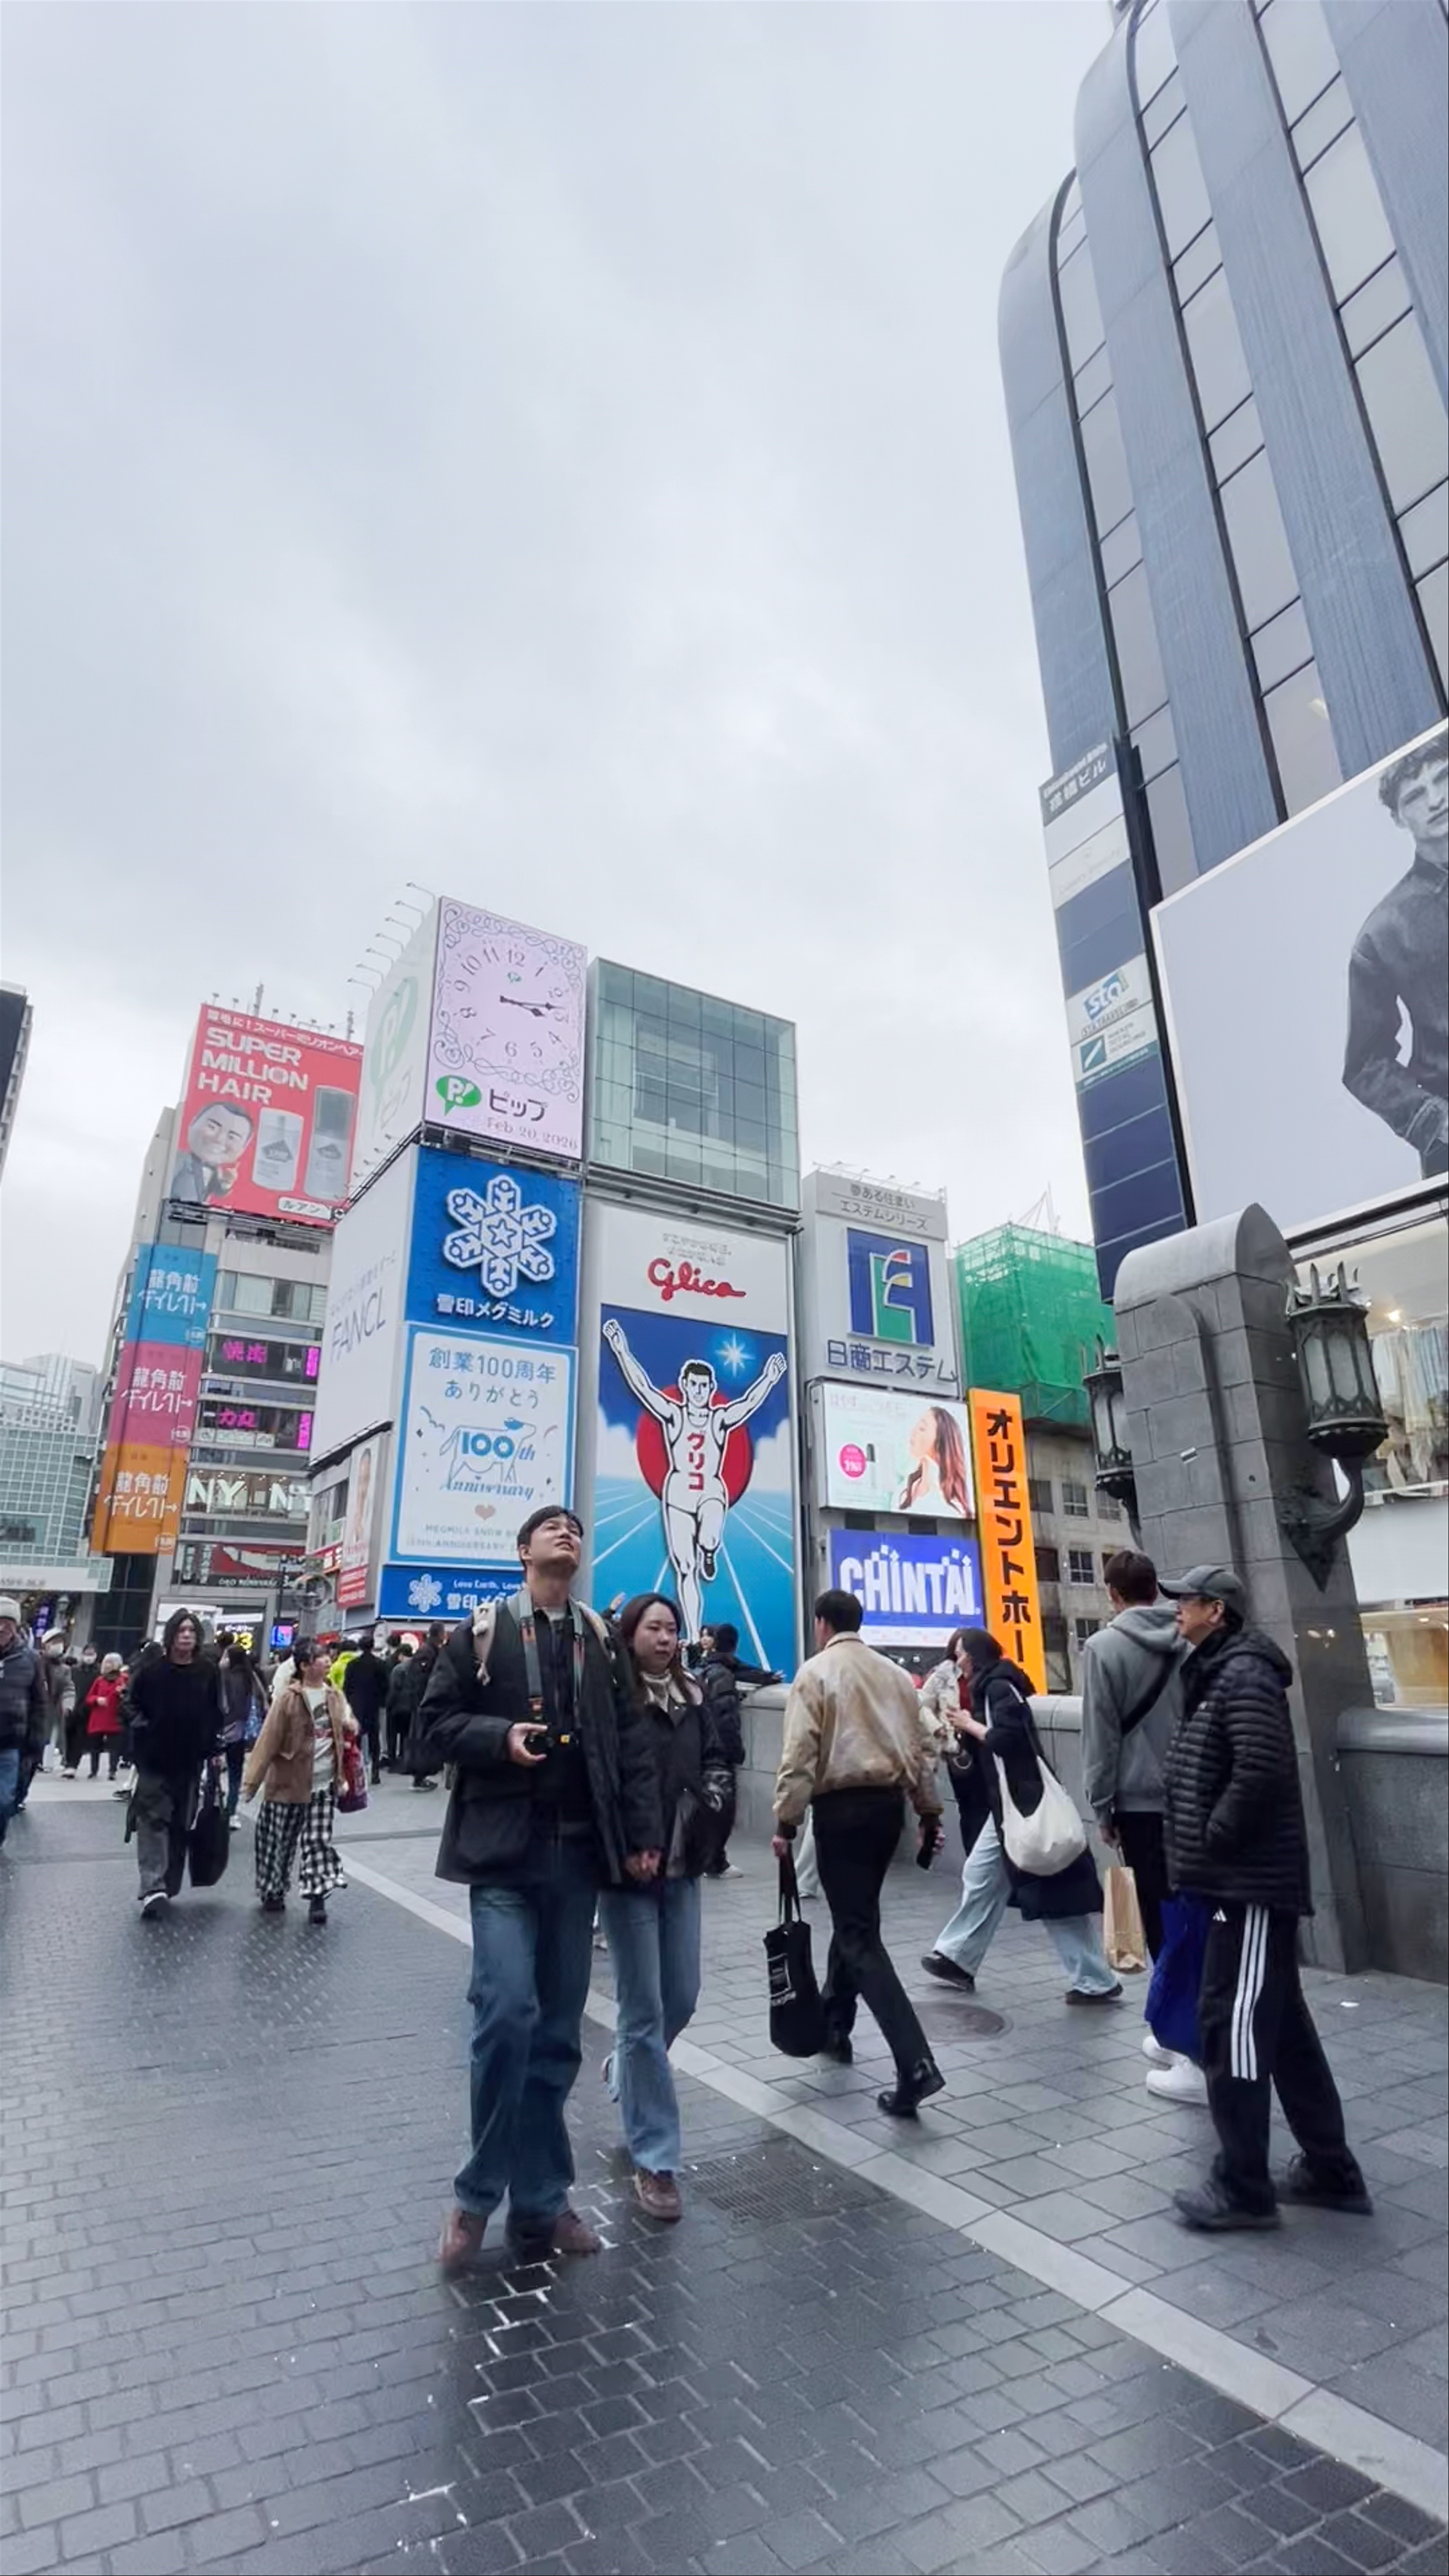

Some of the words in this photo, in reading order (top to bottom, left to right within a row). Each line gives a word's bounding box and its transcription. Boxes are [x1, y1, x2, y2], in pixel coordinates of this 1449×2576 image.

[460, 955, 482, 975] 10
[483, 946, 500, 963] 11
[508, 949, 525, 967] 12
[205, 1027, 302, 1066] SUPER
[505, 1041, 517, 1057] 6
[530, 1041, 543, 1058] 5
[201, 1049, 309, 1090] MILLION
[197, 1072, 272, 1105] HAIR
[489, 1088, 548, 1122] ピップ
[488, 1117, 513, 1133] Feb
[543, 1132, 578, 1150] 2026
[648, 1258, 747, 1301] Glico
[329, 1286, 386, 1366] FANCL
[428, 1346, 557, 1383] 創業100周年
[444, 1379, 539, 1410] ありがとう
[687, 1430, 707, 1491] グリコ
[189, 1478, 245, 1513] NY
[439, 1482, 535, 1501] Anniversary
[986, 1408, 1032, 1668] オリエントホー
